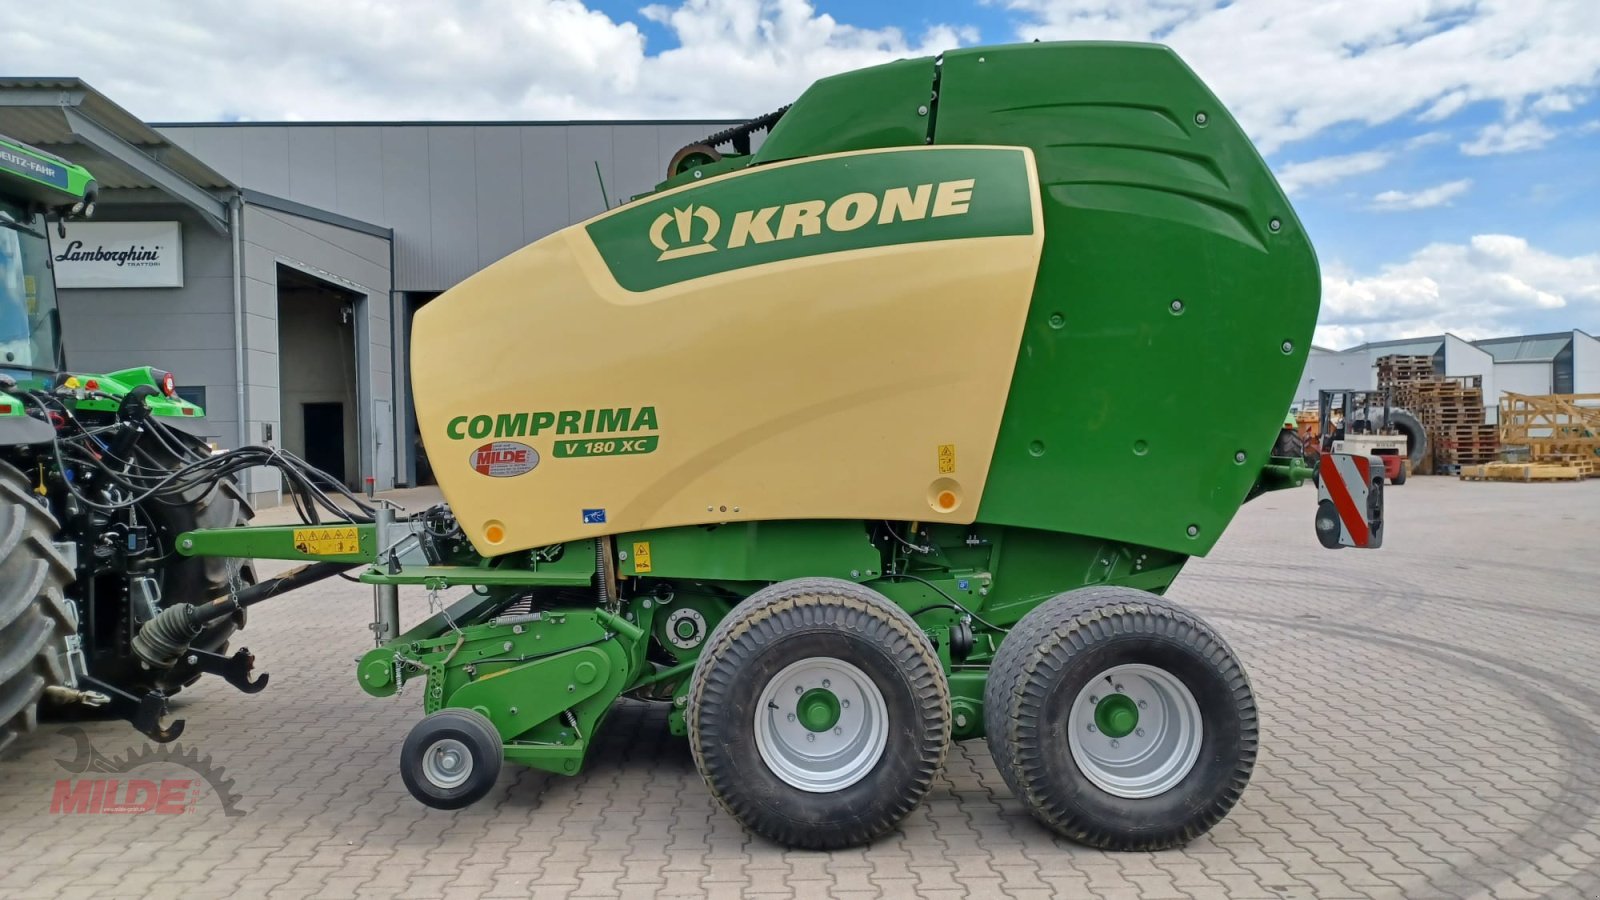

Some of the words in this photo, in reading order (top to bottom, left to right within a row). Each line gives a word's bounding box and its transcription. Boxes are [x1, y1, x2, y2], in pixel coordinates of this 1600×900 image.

[0, 151, 55, 177] EUTZ-FAHR
[727, 179, 975, 248] KRONE
[55, 240, 160, 266] Lamborghini
[446, 406, 659, 440] COMPRIMA
[477, 450, 527, 465] MILDE
[565, 443, 579, 455] V
[585, 441, 615, 454] 180
[620, 439, 648, 452] XC
